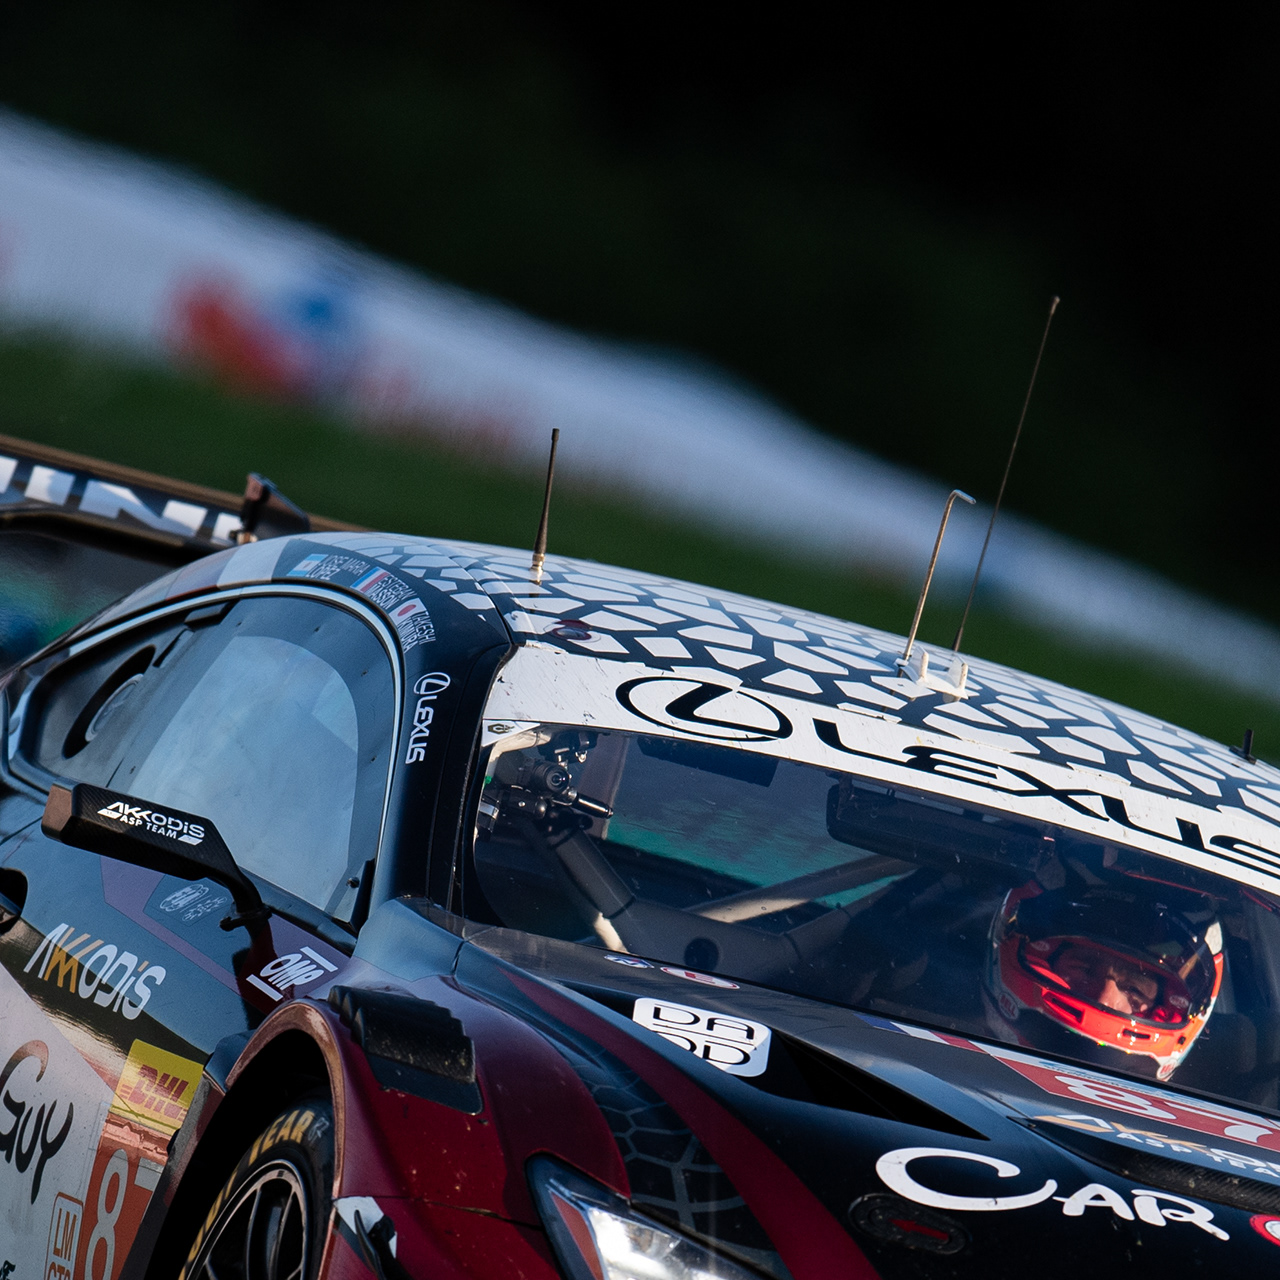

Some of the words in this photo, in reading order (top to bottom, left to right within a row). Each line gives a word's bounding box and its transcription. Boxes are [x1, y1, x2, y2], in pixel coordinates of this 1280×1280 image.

[405, 695, 438, 764] LEXUS
[106, 801, 205, 838] AKKODIS
[120, 814, 144, 828] ASP
[146, 821, 178, 840] TEAM
[23, 923, 167, 1021] AKKODIS
[259, 953, 325, 991] OMP
[1054, 1075, 1274, 1144] 87
[1116, 1132, 1193, 1154] ASP
[875, 1146, 1230, 1241] CAR
[52, 1207, 77, 1262] LM
